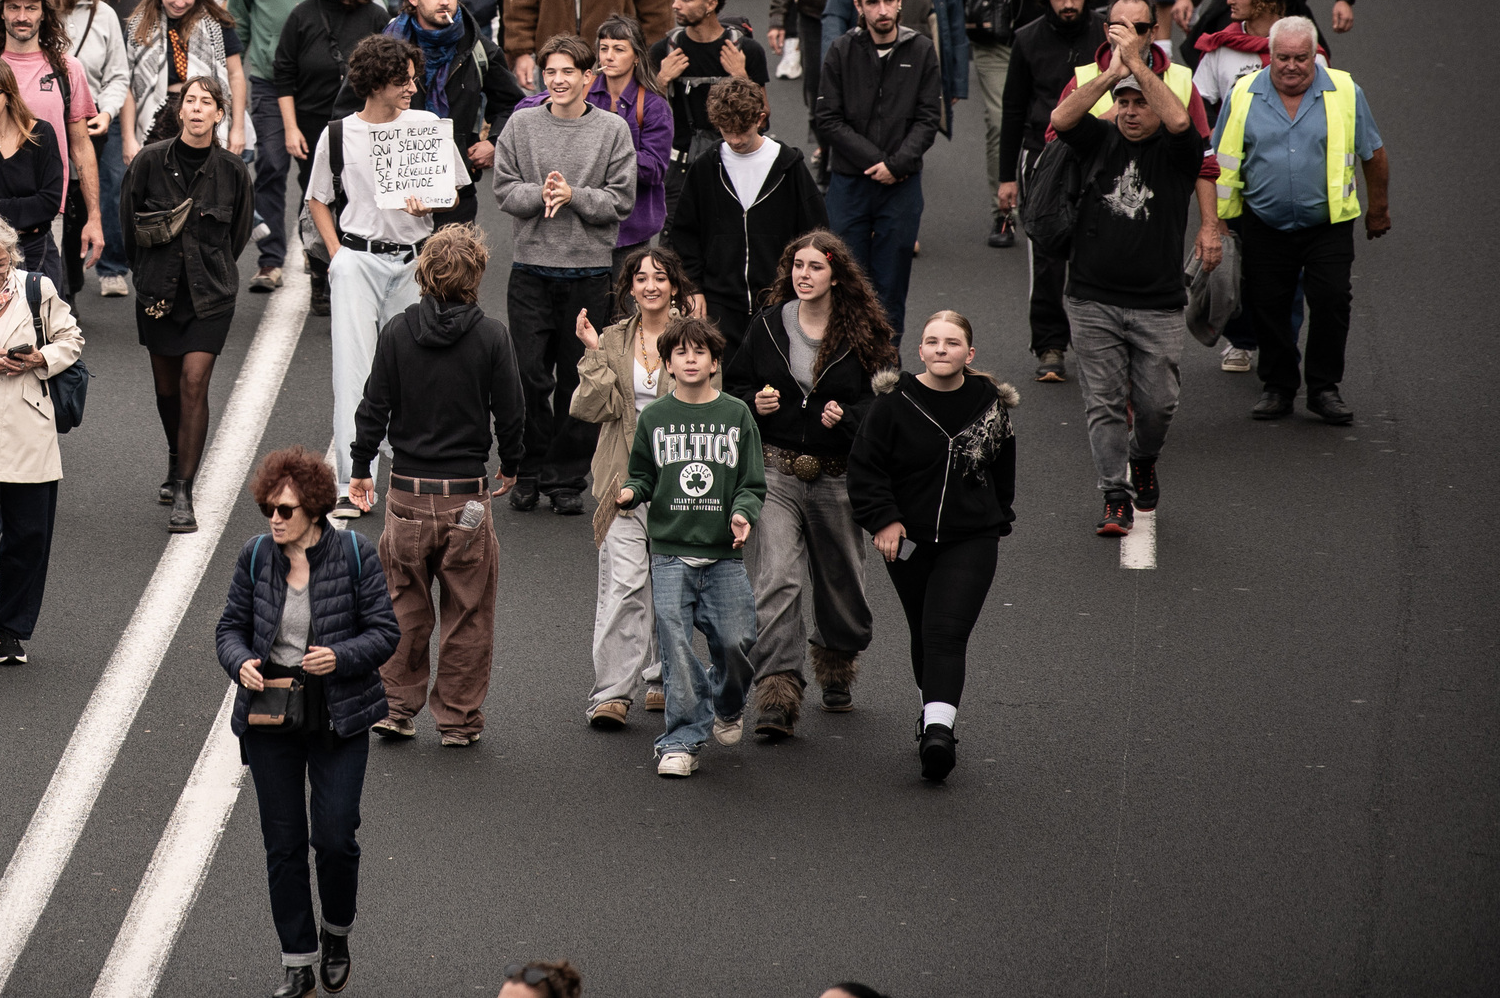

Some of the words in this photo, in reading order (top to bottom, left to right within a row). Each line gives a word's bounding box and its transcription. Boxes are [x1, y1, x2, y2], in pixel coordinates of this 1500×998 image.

[370, 129, 402, 142] TOUT
[407, 126, 439, 137] PEUPLE
[397, 138, 443, 153] S'ENDORT
[376, 157, 393, 172] EN
[377, 170, 393, 183] SE
[435, 164, 448, 175] EN
[670, 423, 726, 433] BOSTON
[652, 426, 740, 469] CELTICS
[682, 464, 712, 479] CELTICS
